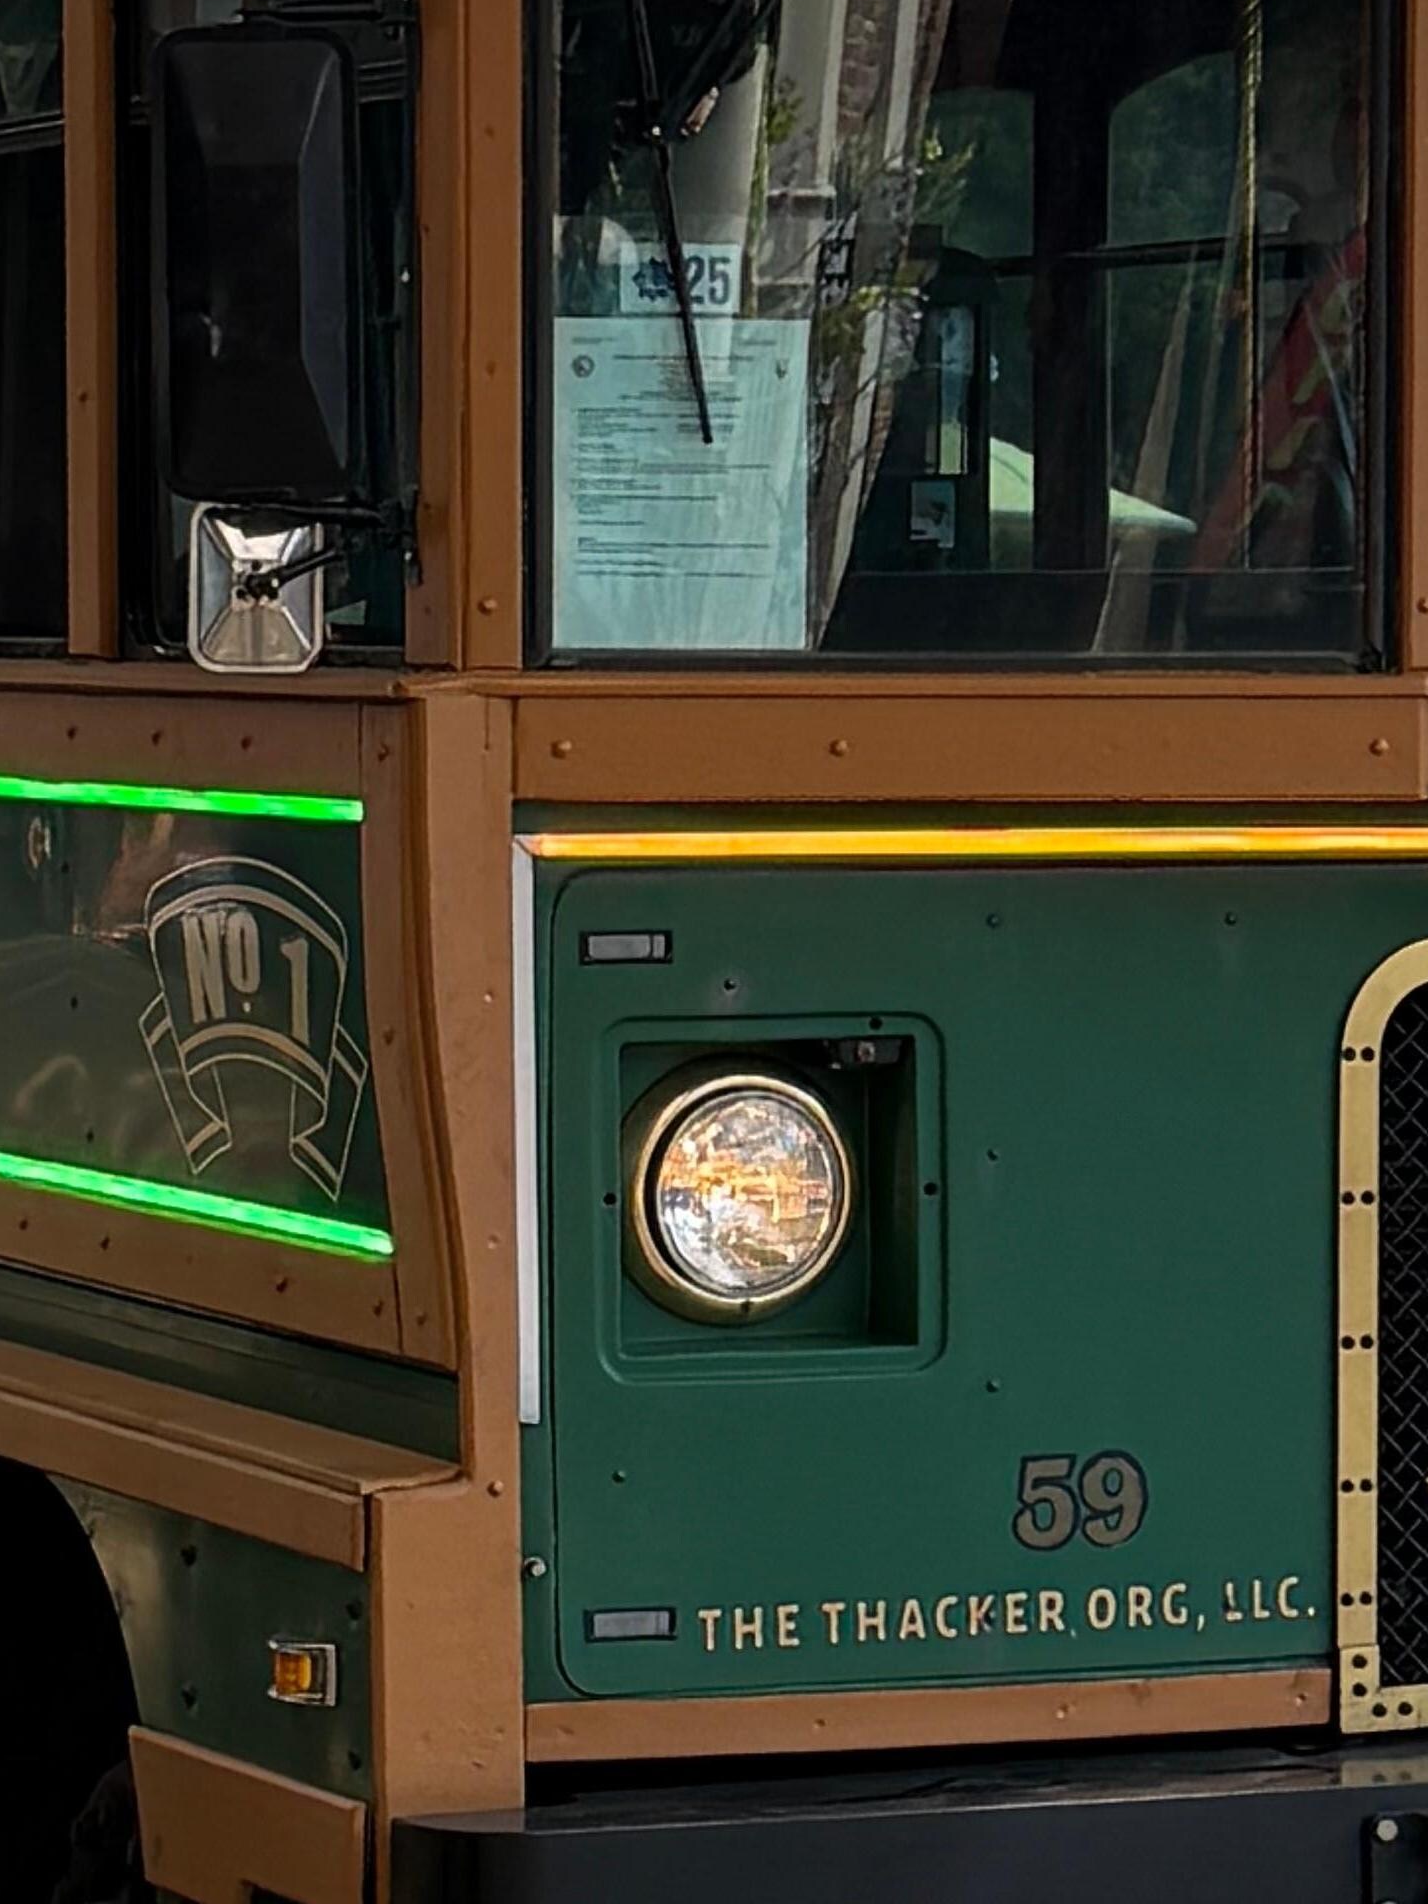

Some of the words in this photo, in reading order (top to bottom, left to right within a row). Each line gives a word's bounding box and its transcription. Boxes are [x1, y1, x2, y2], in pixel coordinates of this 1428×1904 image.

[280, 937, 310, 1048] 1
[1012, 1450, 1149, 1552] 59
[698, 1605, 801, 1652] THE
[821, 1592, 1066, 1645] THACKER
[1223, 1575, 1317, 1622] LLC.
